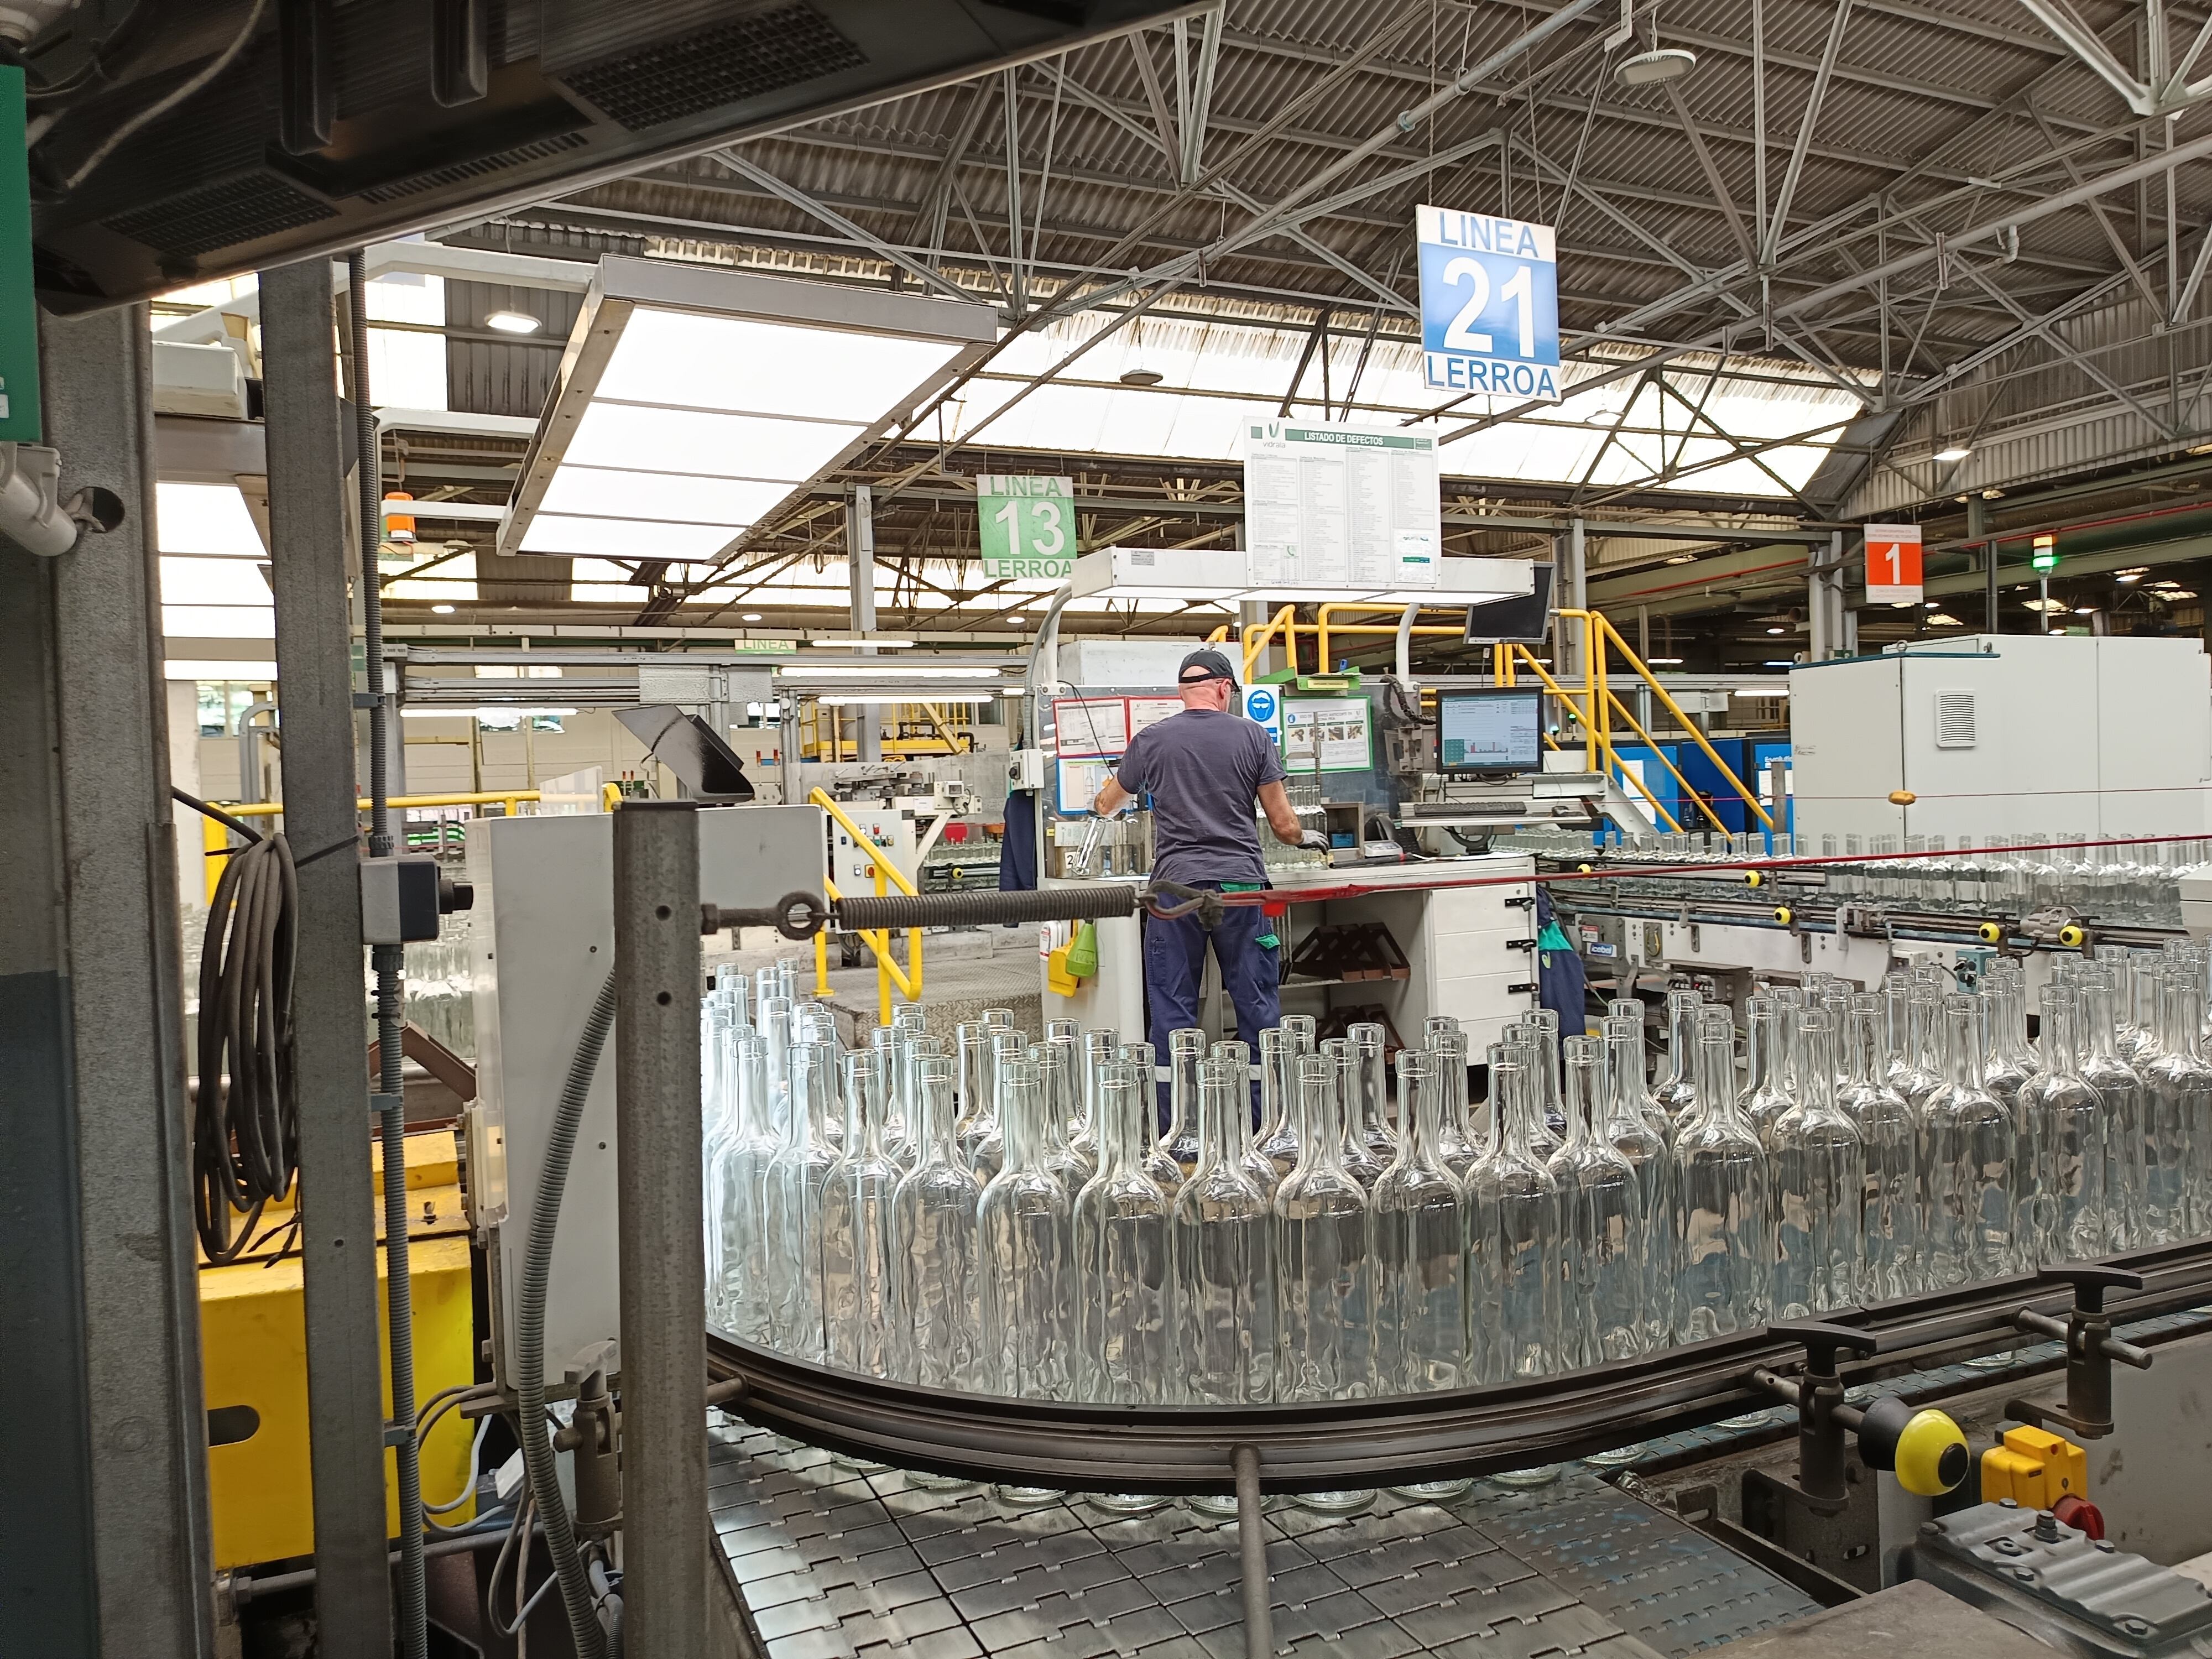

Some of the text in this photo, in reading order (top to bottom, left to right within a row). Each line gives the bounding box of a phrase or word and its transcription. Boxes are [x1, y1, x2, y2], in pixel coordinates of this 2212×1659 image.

[1439, 211, 1538, 258] LINEA
[1442, 257, 1535, 358] 21
[1427, 356, 1557, 398] LERROA
[1304, 432, 1384, 445] LISTADO DE DEFECTOS
[990, 476, 1062, 497] LINEA
[995, 500, 1065, 556] 13
[984, 560, 1071, 578] LERROA
[1885, 544, 1901, 585] 1
[744, 640, 789, 649] LINEA
